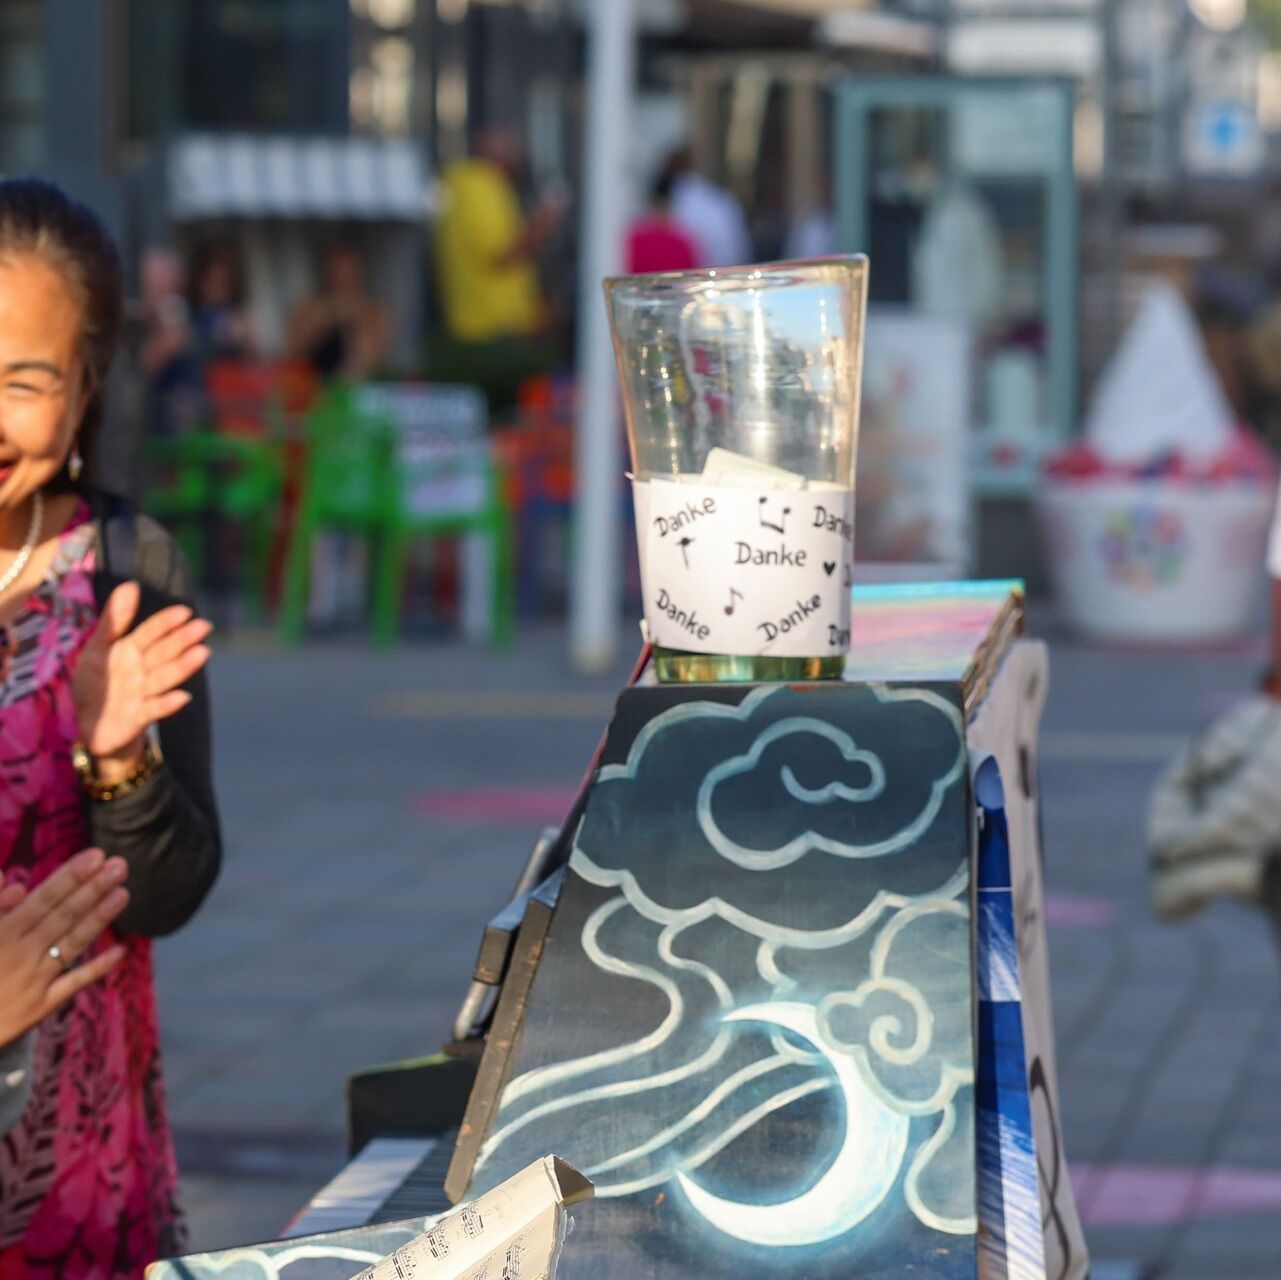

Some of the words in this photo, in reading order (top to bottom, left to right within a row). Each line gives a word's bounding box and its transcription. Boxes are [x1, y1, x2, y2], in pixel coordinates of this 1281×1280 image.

[654, 496, 717, 537] Danke
[734, 541, 807, 567] Danke
[656, 588, 710, 640] Danke
[757, 593, 822, 642] Danke
